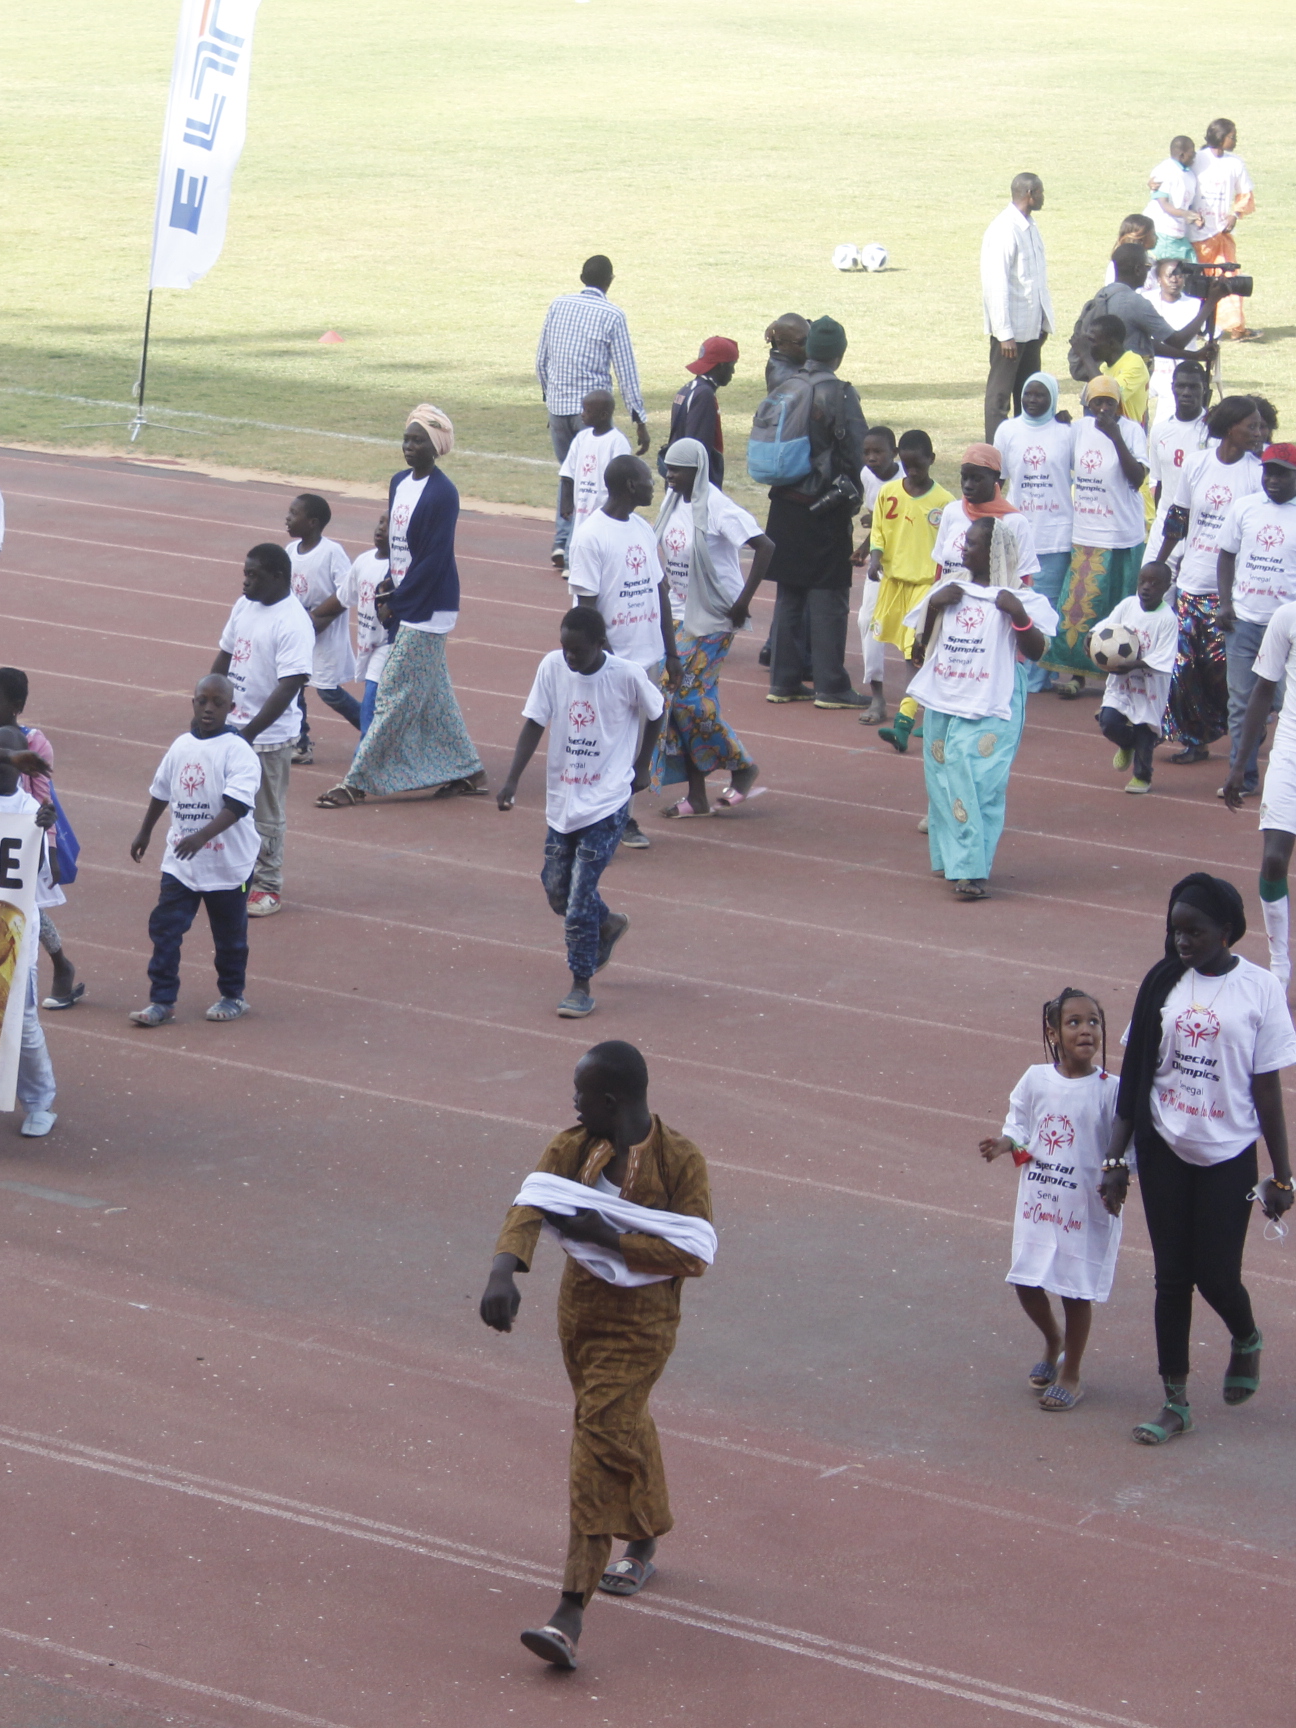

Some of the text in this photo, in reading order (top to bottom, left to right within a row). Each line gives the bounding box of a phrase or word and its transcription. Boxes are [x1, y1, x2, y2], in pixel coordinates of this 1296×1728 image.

[1174, 448, 1185, 468] 8
[885, 496, 899, 520] 2
[947, 635, 983, 645] Special
[1174, 1049, 1218, 1068] Special
[1171, 1060, 1221, 1082] Olympics
[1035, 1160, 1075, 1175] Special
